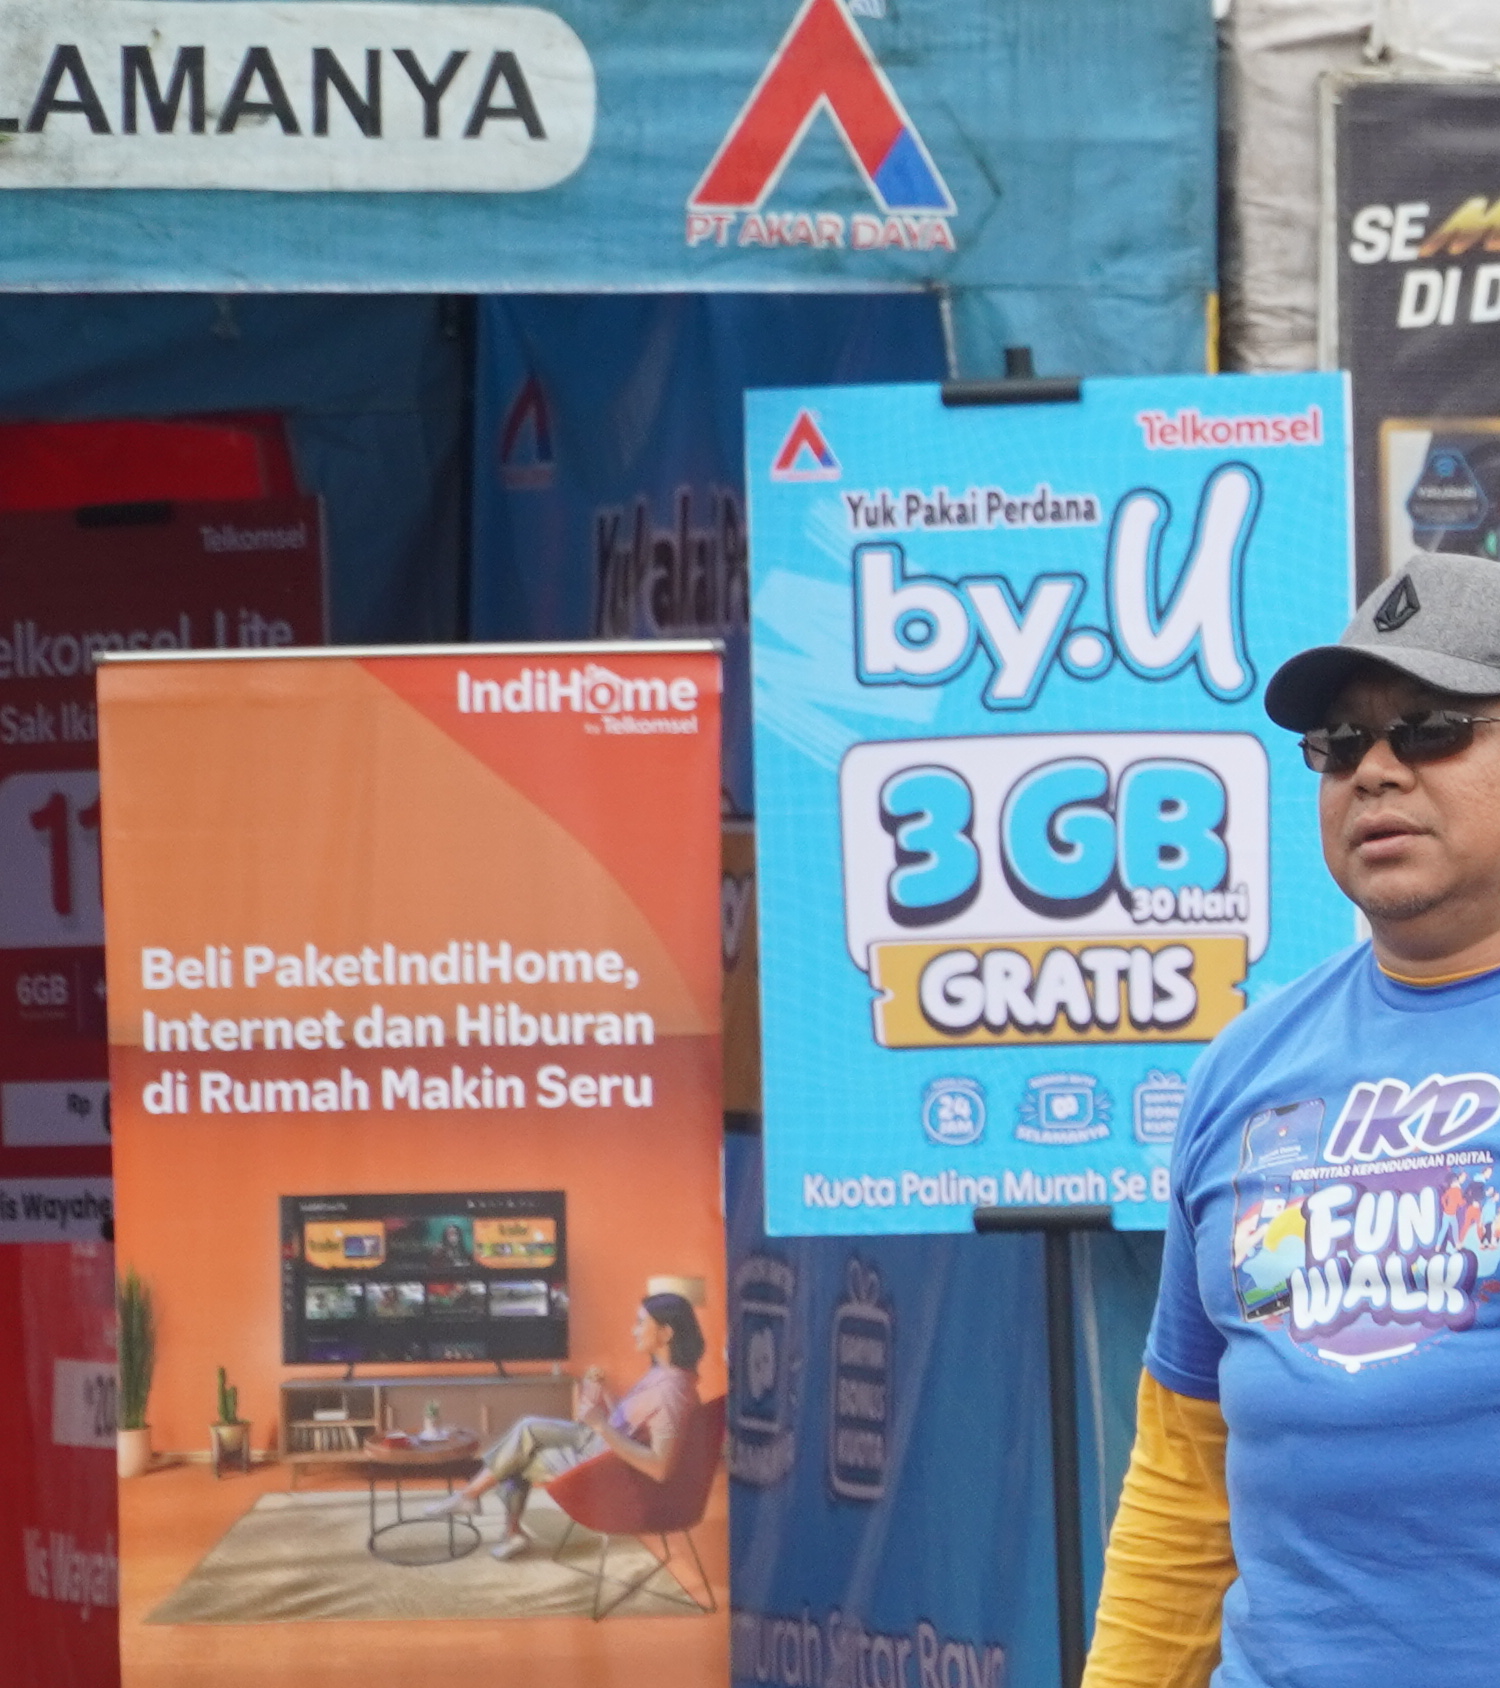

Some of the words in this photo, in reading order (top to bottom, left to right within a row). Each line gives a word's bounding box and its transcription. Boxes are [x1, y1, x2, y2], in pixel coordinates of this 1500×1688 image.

[0, 44, 548, 140] AMANYA
[687, 214, 732, 247] PT
[739, 214, 843, 248] AKAR
[851, 214, 956, 253] DAYA
[1399, 266, 1459, 328] DI
[1138, 406, 1322, 447] Telkomsel
[846, 493, 896, 529] Yuk
[905, 494, 979, 527] Pakai
[985, 491, 1099, 526] Perdana
[457, 664, 697, 713] IndiHome
[602, 715, 697, 735] Telkomsel
[1131, 884, 1176, 923] 30
[1184, 883, 1249, 922] Hari
[141, 946, 233, 991] Beli
[920, 946, 1198, 1034] GRATIS
[142, 1008, 345, 1052] Internet
[354, 1006, 444, 1050] dan
[455, 1004, 655, 1047] Hiburan
[143, 1072, 189, 1115] di
[200, 1069, 370, 1113] Rumah
[382, 1066, 525, 1110] Makin
[537, 1066, 654, 1108] Seru
[804, 1172, 896, 1209] Kuota
[902, 1171, 998, 1207] Paling
[1004, 1166, 1104, 1203] Murah
[1111, 1166, 1147, 1202] Se
[1292, 1163, 1349, 1181] IDENTITAS
[1351, 1155, 1444, 1177] KEPENDUDUKAN
[1446, 1151, 1493, 1166] DIGITAL
[1307, 1183, 1439, 1261] FUN
[1289, 1252, 1469, 1330] WALK
